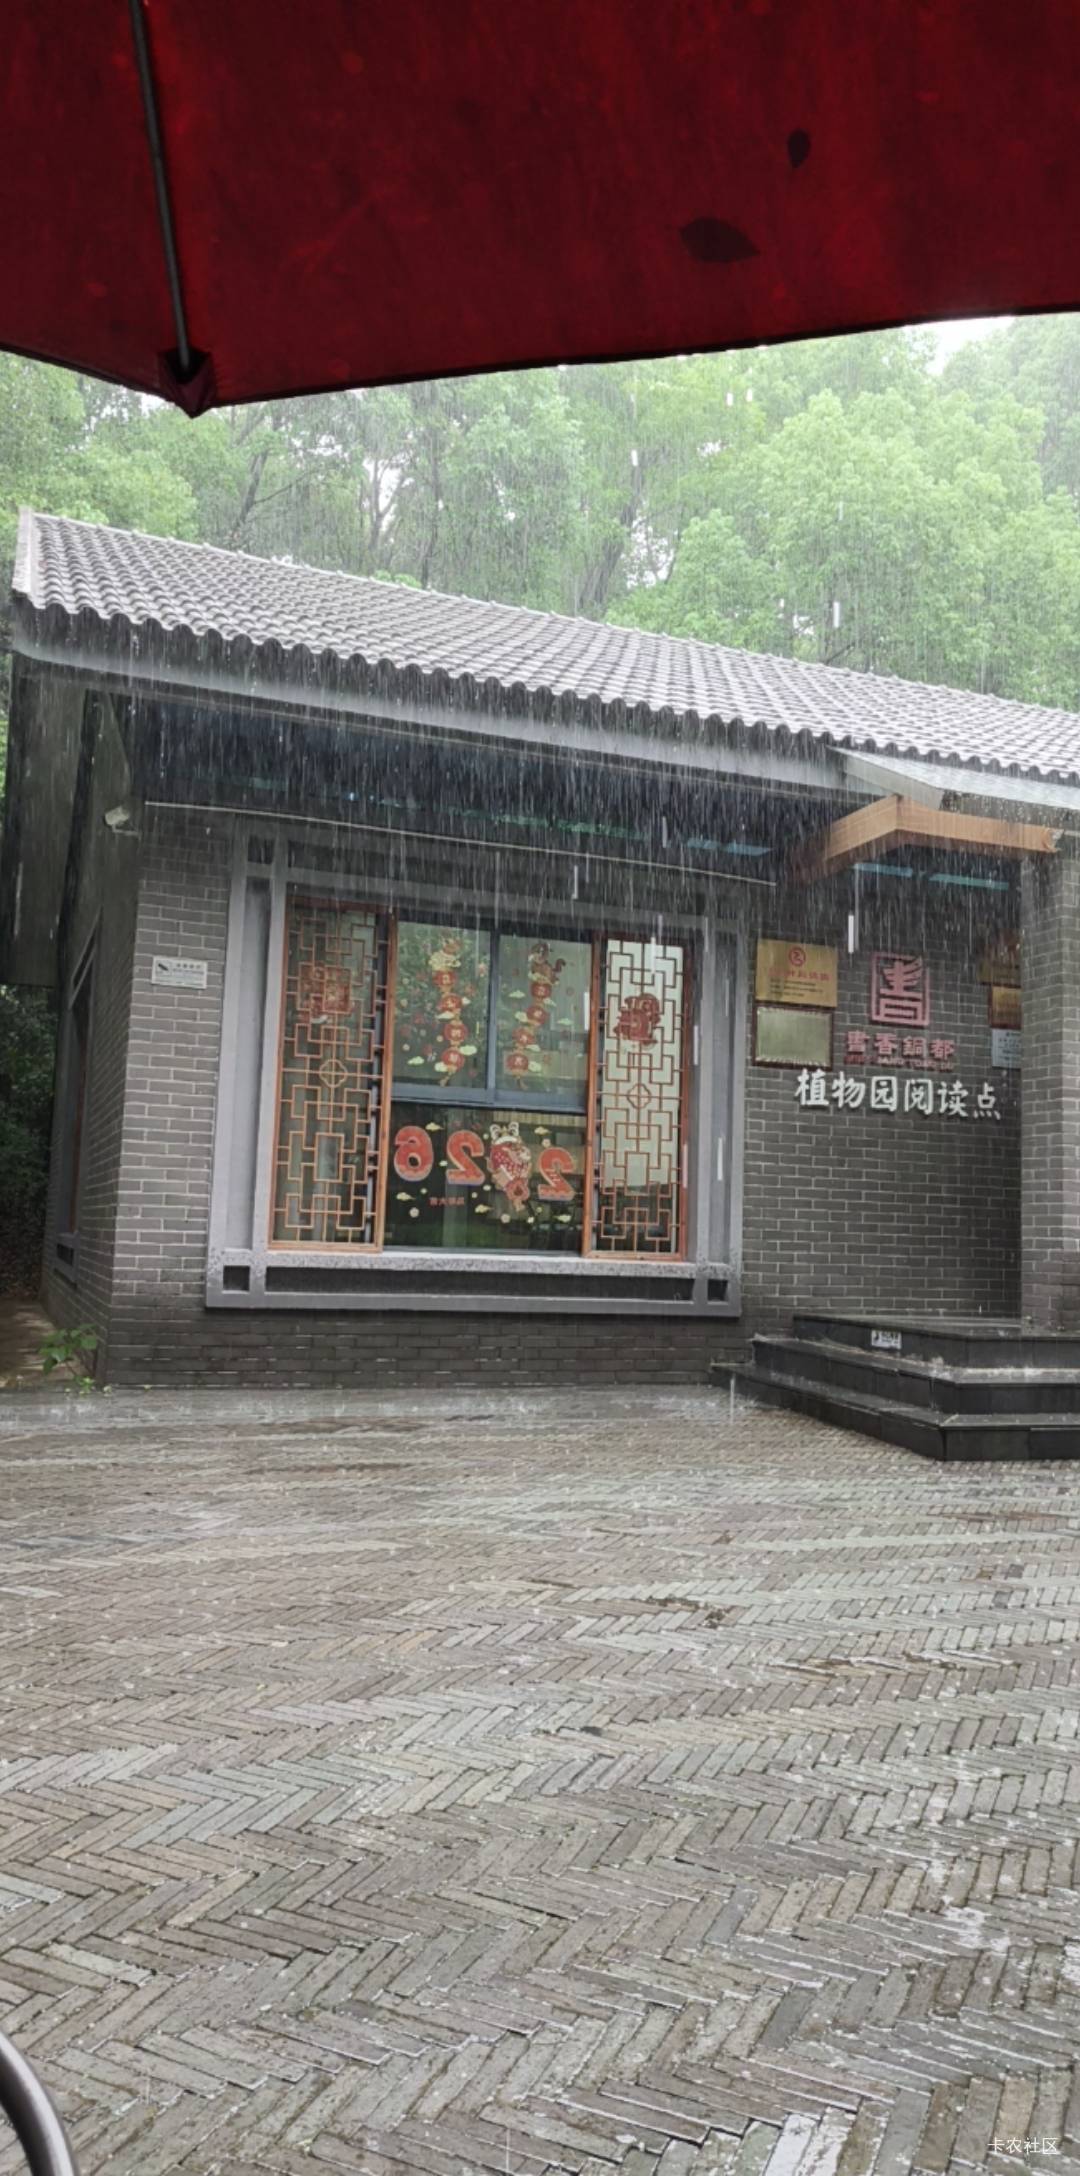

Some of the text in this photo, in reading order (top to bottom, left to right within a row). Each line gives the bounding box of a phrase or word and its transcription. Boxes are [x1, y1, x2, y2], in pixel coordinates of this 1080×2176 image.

[847, 1030, 955, 1061] 書香銅都
[794, 1068, 1002, 1121] 植物园阅读点
